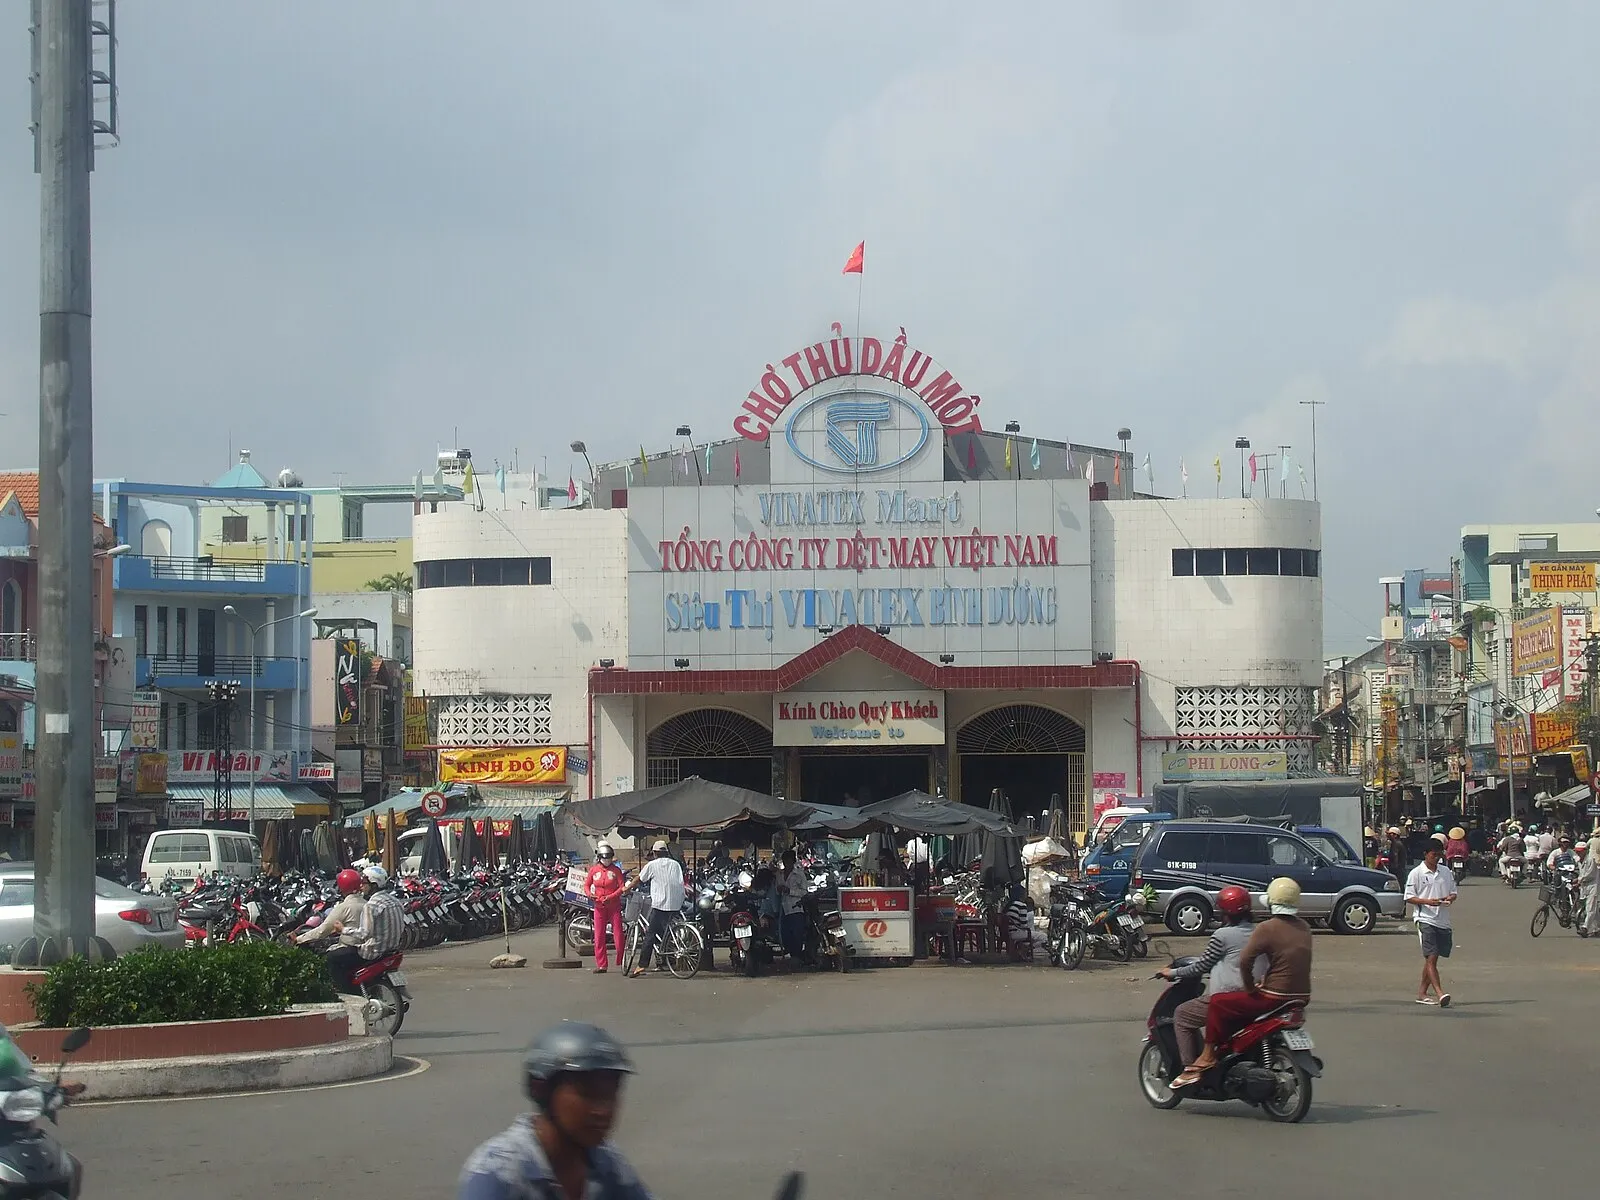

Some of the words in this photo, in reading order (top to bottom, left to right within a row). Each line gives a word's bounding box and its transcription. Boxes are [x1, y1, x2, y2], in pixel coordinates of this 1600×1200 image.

[782, 322, 852, 390] THỦ
[758, 489, 866, 527] VINATEX
[875, 489, 963, 525] Mart
[658, 526, 723, 572] TỔNG
[728, 531, 794, 572] CÔNG
[798, 536, 831, 570] TY
[942, 527, 999, 572] VIỆT
[1003, 535, 1059, 568] NAM
[1533, 574, 1563, 590] THỊNH
[1567, 570, 1594, 588] PHÁT
[666, 591, 721, 633] Siêu
[725, 588, 774, 642] Thị
[779, 587, 924, 629] VINATEX
[929, 579, 984, 627] BÌNH
[778, 701, 816, 720] Kính
[820, 700, 856, 721] Chào
[859, 700, 888, 725] Quý
[891, 699, 938, 720] Khách
[811, 725, 881, 740] Welcome
[887, 726, 905, 739] to
[456, 760, 503, 774] KINH
[508, 757, 535, 773] ĐÔ
[1188, 757, 1216, 770] PHI
[1220, 757, 1260, 770] LONG
